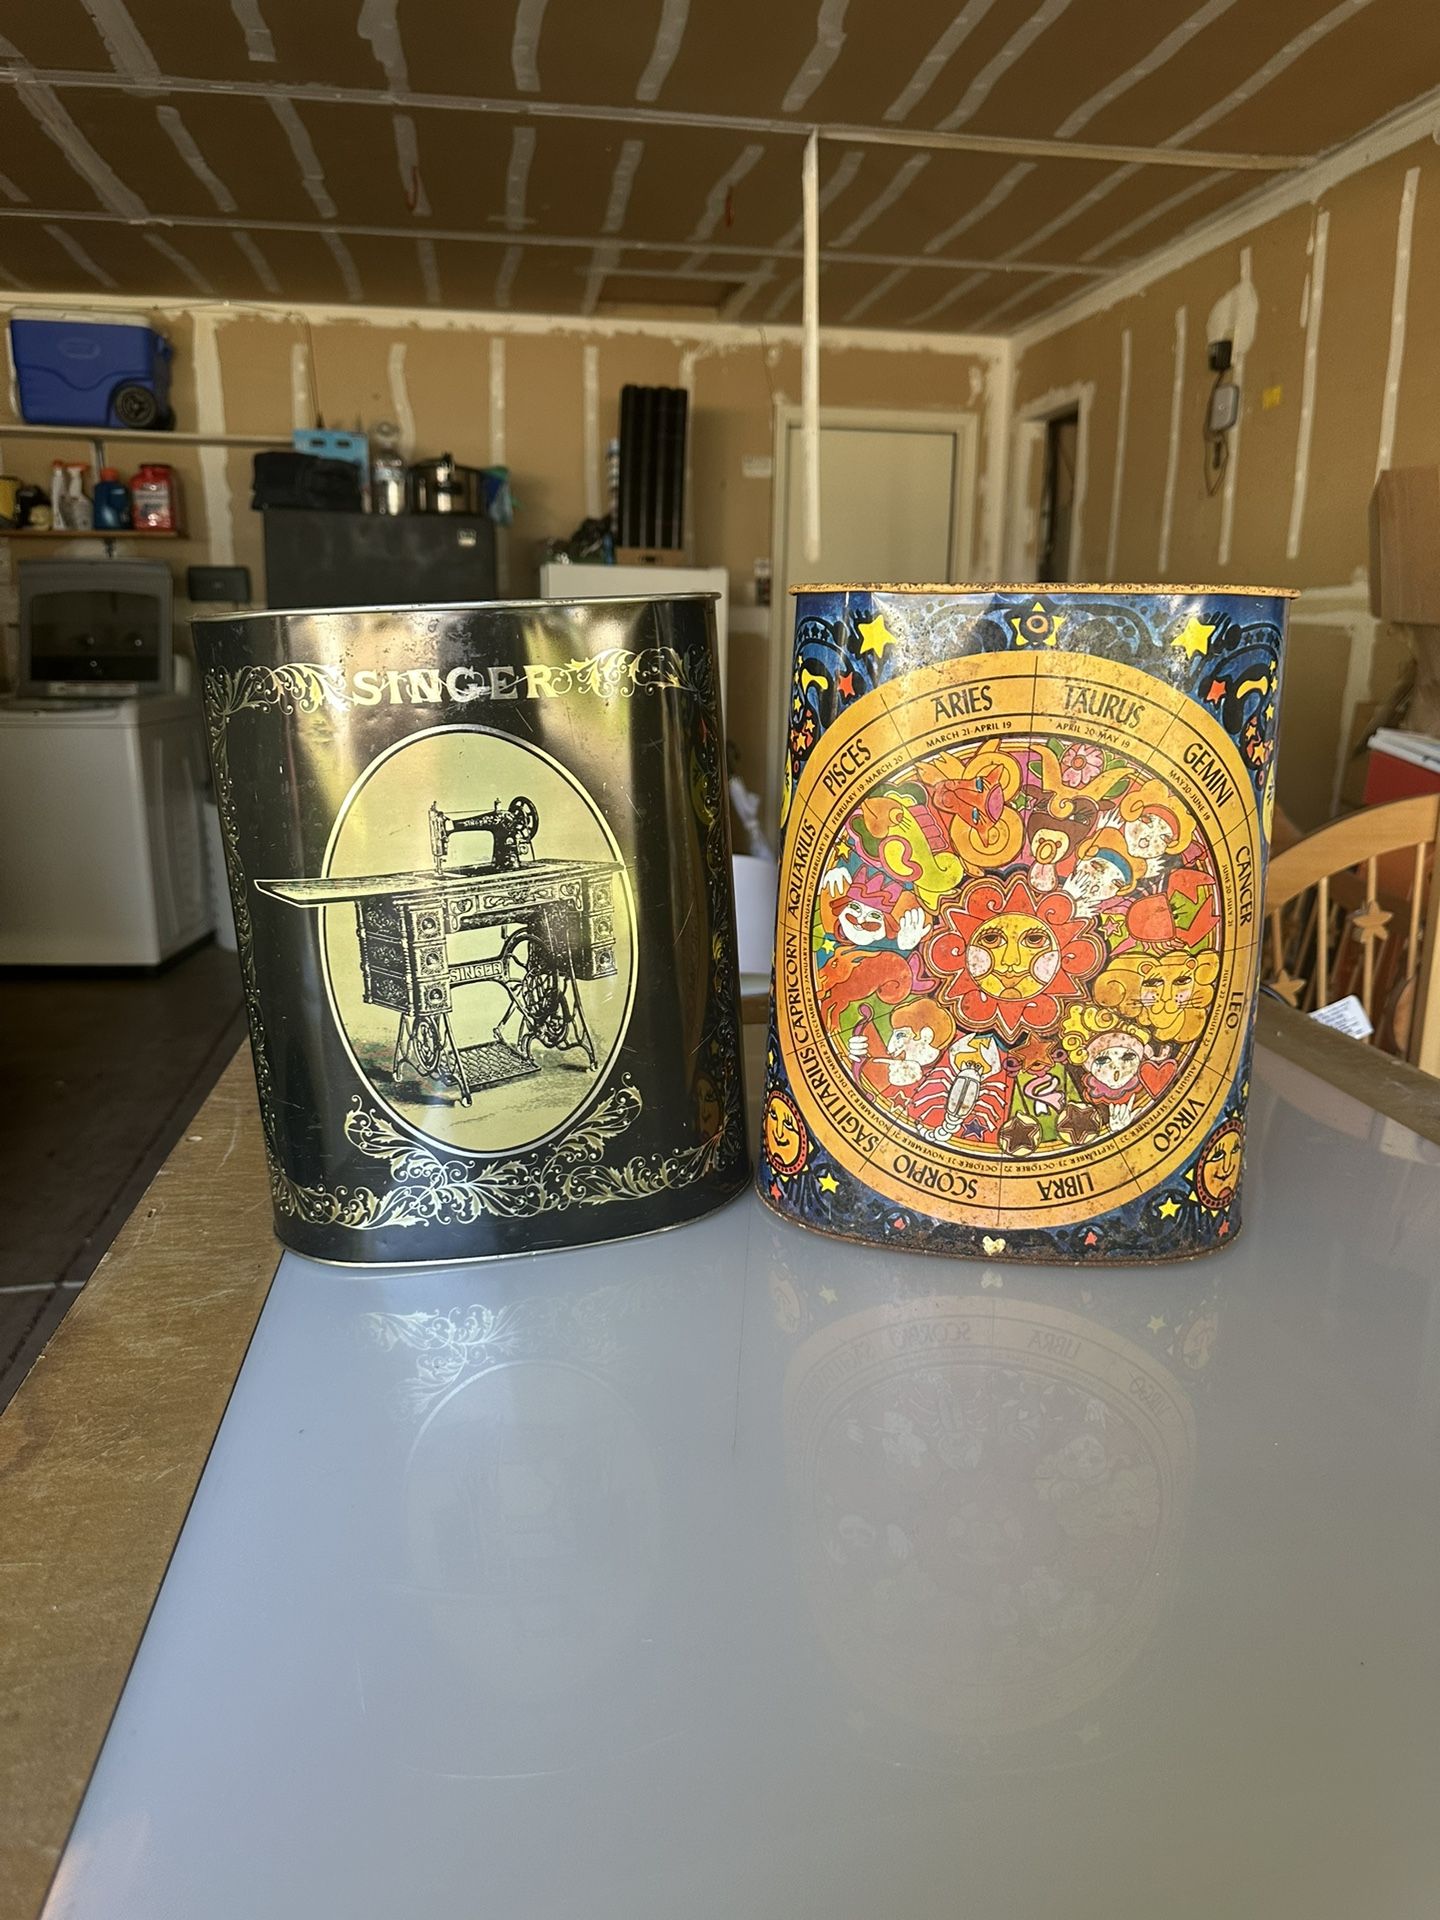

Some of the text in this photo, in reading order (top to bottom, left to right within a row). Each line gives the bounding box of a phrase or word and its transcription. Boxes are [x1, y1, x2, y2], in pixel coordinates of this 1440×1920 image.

[352, 665, 559, 706] SINGER
[930, 685, 993, 722] ARIES
[1065, 684, 1146, 729] TAURUS
[926, 731, 960, 748] MARCH
[1002, 721, 1012, 729] 19
[1056, 722, 1081, 733] APRIL
[1121, 740, 1131, 749] 19
[822, 738, 871, 797] PISCES
[1183, 742, 1234, 808] GEMINI
[832, 791, 857, 825] FEBRUARY
[893, 755, 904, 765] 20
[1202, 811, 1211, 821] 19
[788, 818, 816, 920] AQUARIUS
[1222, 864, 1231, 884] JUNE
[1236, 845, 1253, 927] CANCER
[804, 893, 813, 929] JANUARY
[450, 962, 502, 982] SINGER
[786, 932, 810, 1044] CAPRICORN
[808, 998, 822, 1039] DECEMBER
[1208, 1004, 1222, 1035] AUGUST
[1226, 992, 1244, 1029] LEO
[1176, 1065, 1197, 1094] AUGUST
[800, 1047, 880, 1153] SAGITTARIUS
[853, 1097, 890, 1132] NOVEMBER
[1153, 1098, 1206, 1152] VIRGO
[958, 1160, 998, 1172] OCTOBER
[1070, 1143, 1116, 1164] SEPTEMBER
[893, 1154, 979, 1200] SCORPIO
[1036, 1171, 1095, 1202] LIBRA
